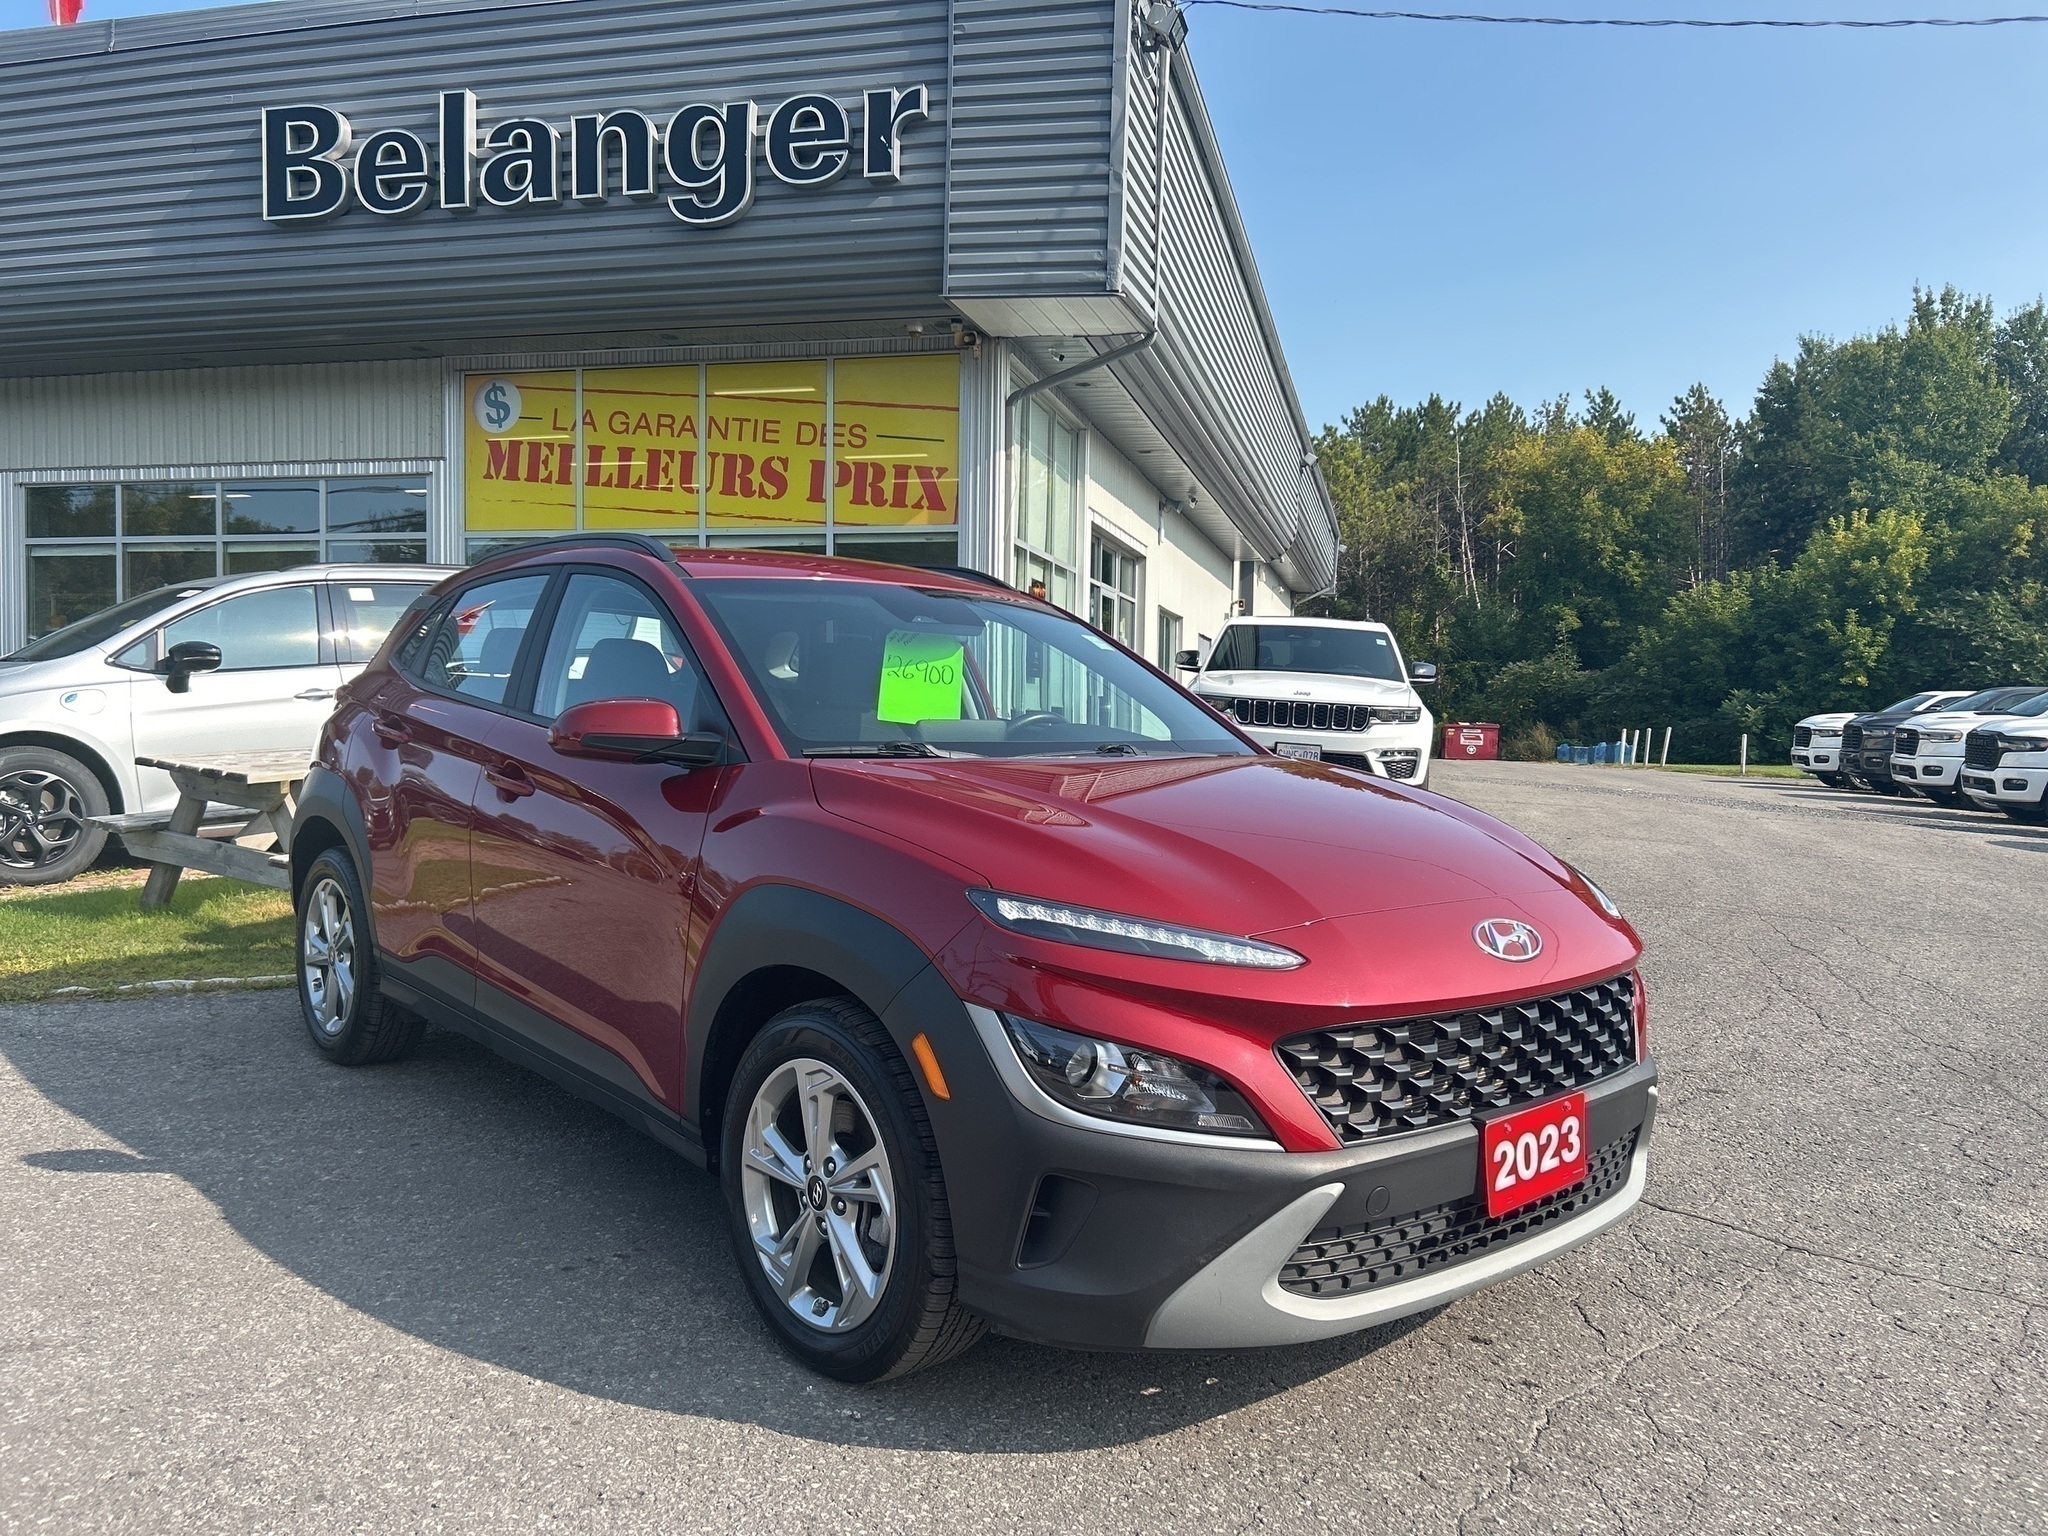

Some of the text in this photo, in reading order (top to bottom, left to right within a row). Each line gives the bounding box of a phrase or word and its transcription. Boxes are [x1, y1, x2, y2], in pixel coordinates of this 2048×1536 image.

[261, 83, 929, 227] Belanger
[484, 381, 512, 428] $
[551, 407, 868, 449] LA GARANTIE DES
[482, 439, 950, 512] MEILLEURS PRIX
[887, 654, 954, 685] 26900
[1493, 1115, 1581, 1192] 2023
